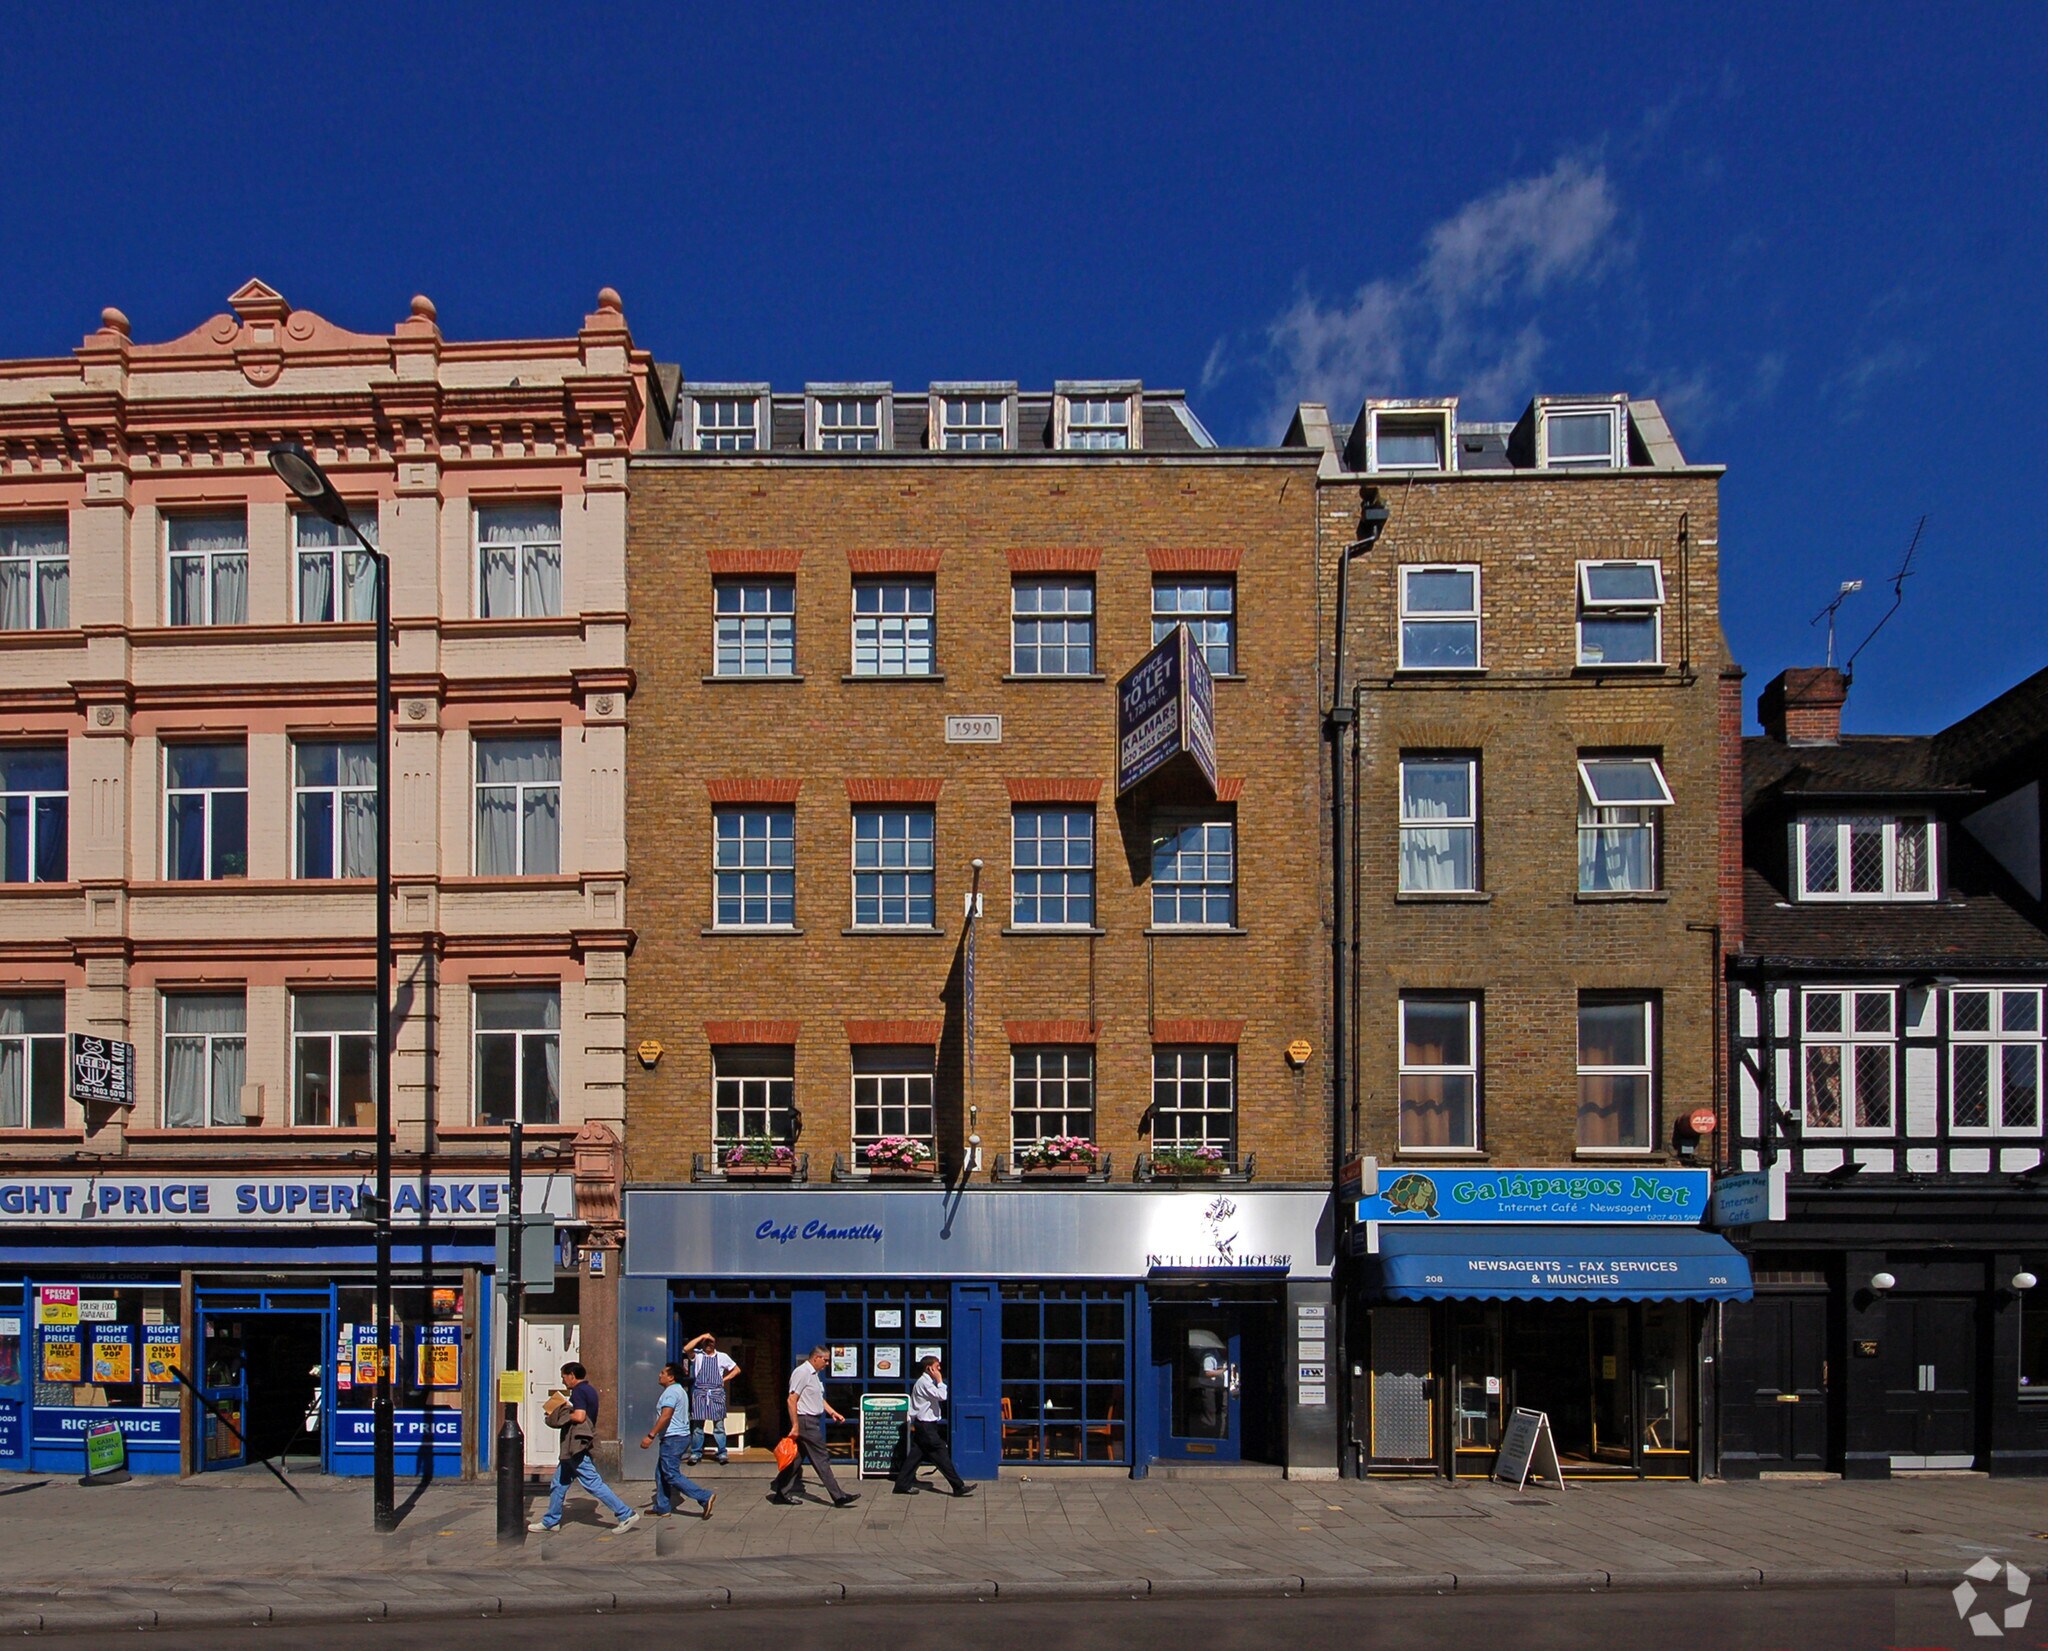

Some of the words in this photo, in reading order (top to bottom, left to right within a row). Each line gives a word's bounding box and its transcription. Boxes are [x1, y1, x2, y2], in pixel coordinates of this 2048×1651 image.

[1132, 653, 1163, 687] OFFICE
[1123, 684, 1141, 712] TO
[1146, 657, 1173, 694] LET
[954, 722, 992, 735] 1990
[1123, 703, 1176, 753] KALMARS
[1123, 750, 1138, 767] 020
[112, 1041, 125, 1063] KATZ
[78, 1056, 93, 1066] LET
[98, 1059, 108, 1069] BY
[112, 1064, 125, 1090] BLACK
[1452, 1174, 1622, 1205] Galápagos
[1630, 1176, 1690, 1207] Net
[0, 1185, 72, 1214] GHT
[99, 1185, 210, 1214] PRICE
[235, 1184, 523, 1214] SUPERARKE
[1720, 1195, 1759, 1209] Internet
[1498, 1203, 1548, 1213] Internet
[1551, 1202, 1578, 1213] Café
[1590, 1203, 1652, 1216] Newsagent
[1729, 1209, 1750, 1221] Café
[755, 1219, 798, 1245] Café
[802, 1219, 883, 1244] Chantilly
[1239, 1254, 1292, 1267] HOUSE
[1468, 1260, 1561, 1272] NEWSAGENTS
[1579, 1261, 1605, 1272] FAX
[1610, 1261, 1679, 1272] SERVICES
[1531, 1274, 1541, 1284] &
[1547, 1274, 1620, 1285] MUNCHIES
[102, 1302, 116, 1310] FOOD
[44, 1325, 77, 1333] RIGHT
[95, 1325, 129, 1333] RIGHT
[421, 1326, 456, 1334] RIGHT
[96, 1335, 128, 1343] PRICE
[422, 1336, 454, 1344] PRICE
[538, 1337, 552, 1352] 214
[354, 1423, 404, 1433] RIT
[409, 1423, 458, 1434] PRICE
[864, 1450, 878, 1458] EAT
[880, 1450, 890, 1458] IN
[864, 1460, 892, 1469] TAKEAW
